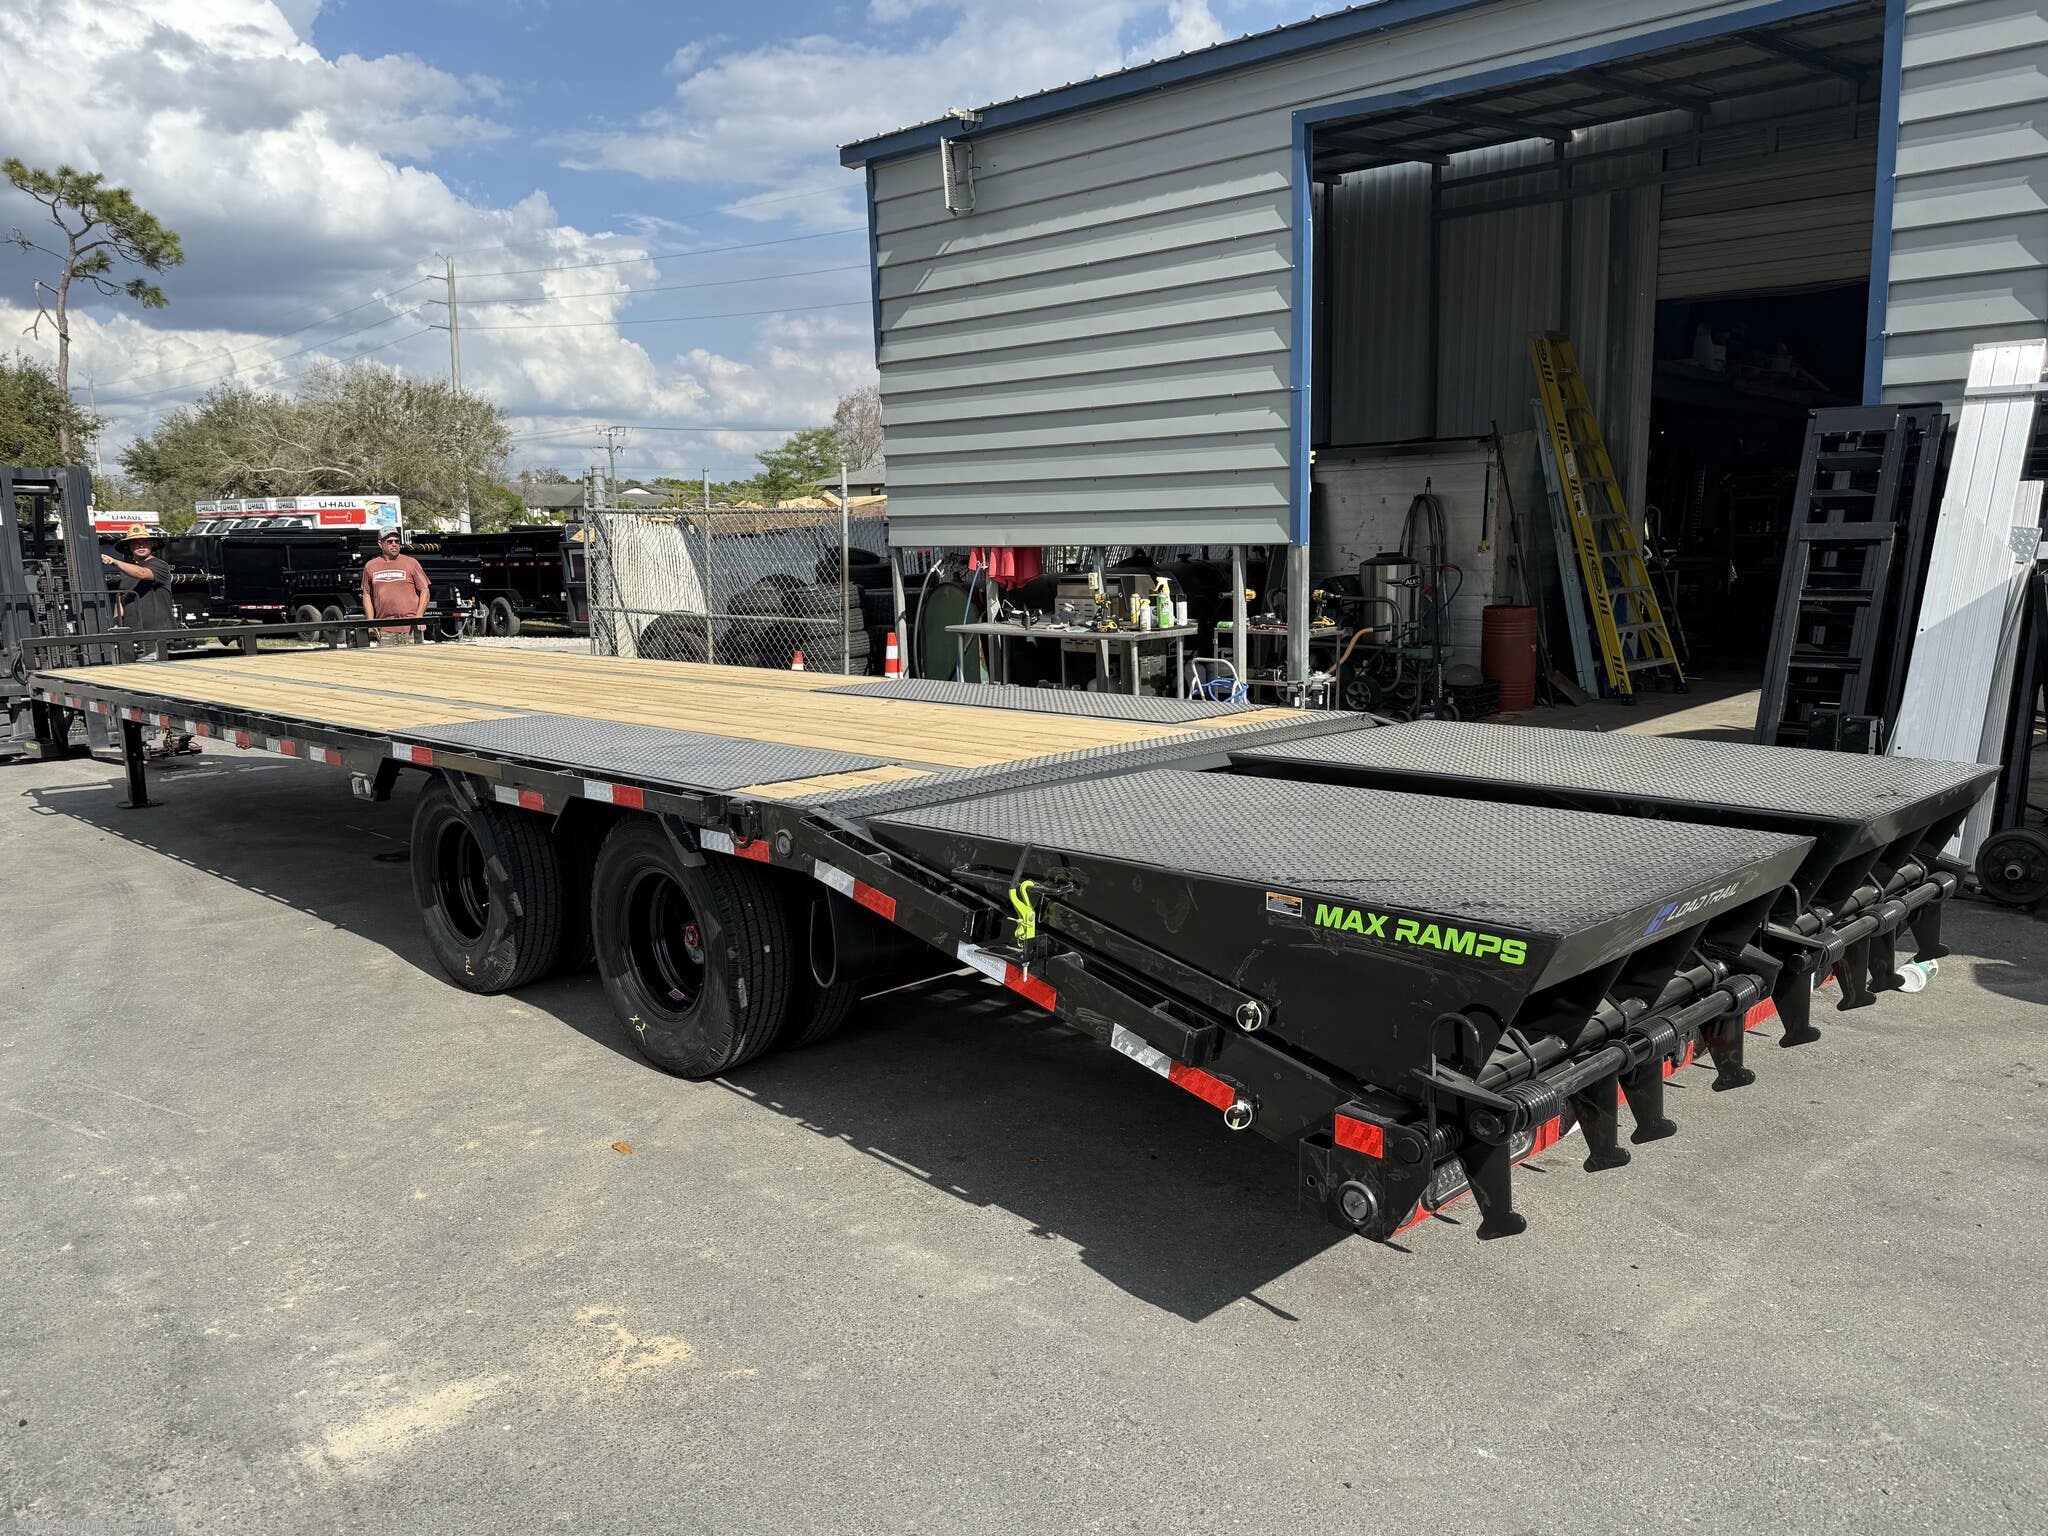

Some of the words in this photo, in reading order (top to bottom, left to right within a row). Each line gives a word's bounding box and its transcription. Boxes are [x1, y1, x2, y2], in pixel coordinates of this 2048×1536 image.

[1666, 894, 1708, 922] LOAD
[1704, 882, 1740, 907] TRAIL
[1314, 903, 1389, 938] MAX
[1394, 918, 1528, 966] RAMPS
